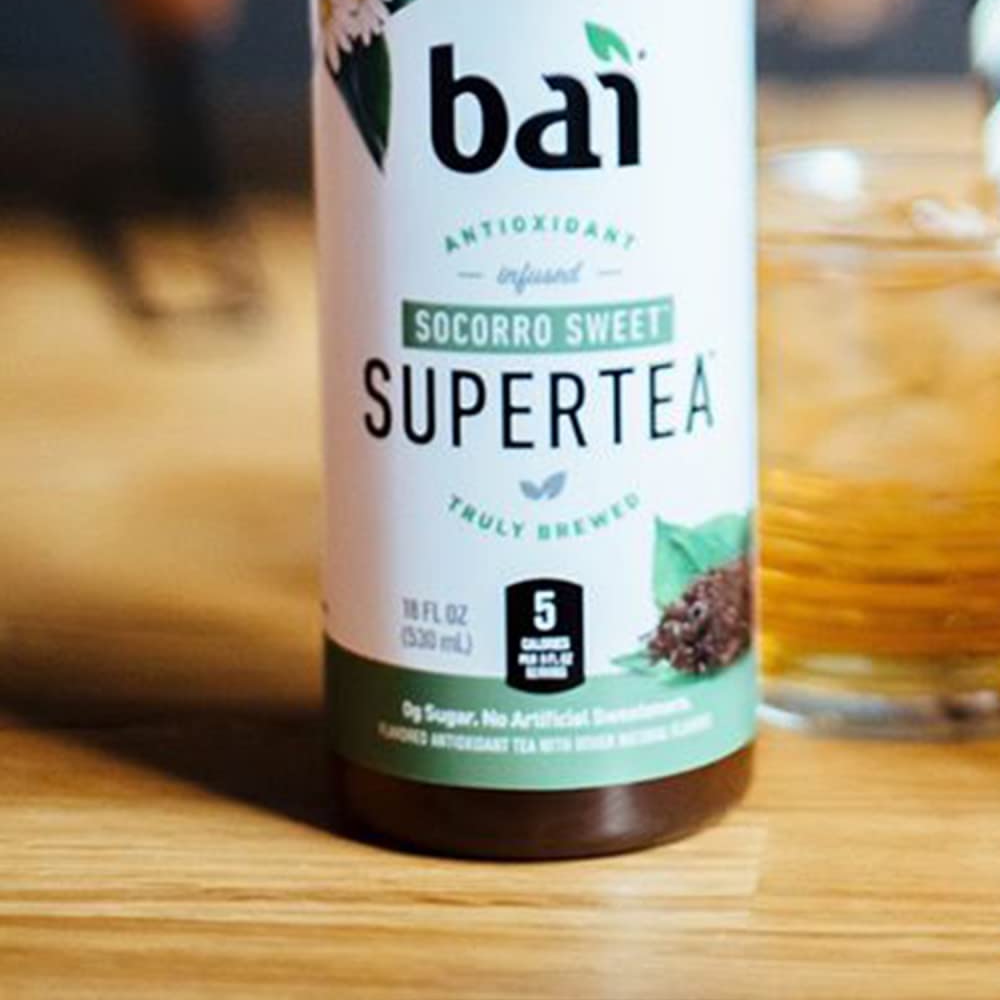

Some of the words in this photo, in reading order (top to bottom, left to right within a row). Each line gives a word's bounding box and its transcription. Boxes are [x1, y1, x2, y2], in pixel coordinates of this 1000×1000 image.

[429, 21, 640, 174] bai
[445, 214, 635, 253] ANTIOXIDANT
[497, 262, 583, 293] infused
[414, 309, 552, 347] SOCORRO
[565, 306, 661, 346] SWEET
[362, 352, 714, 449] SUPERTEA
[449, 494, 525, 538] TRULY
[537, 493, 640, 540] BREWED
[402, 597, 418, 621] 18
[423, 601, 440, 624] FL
[445, 604, 469, 625] OZ
[533, 590, 557, 631] 5
[482, 709, 508, 727] No
